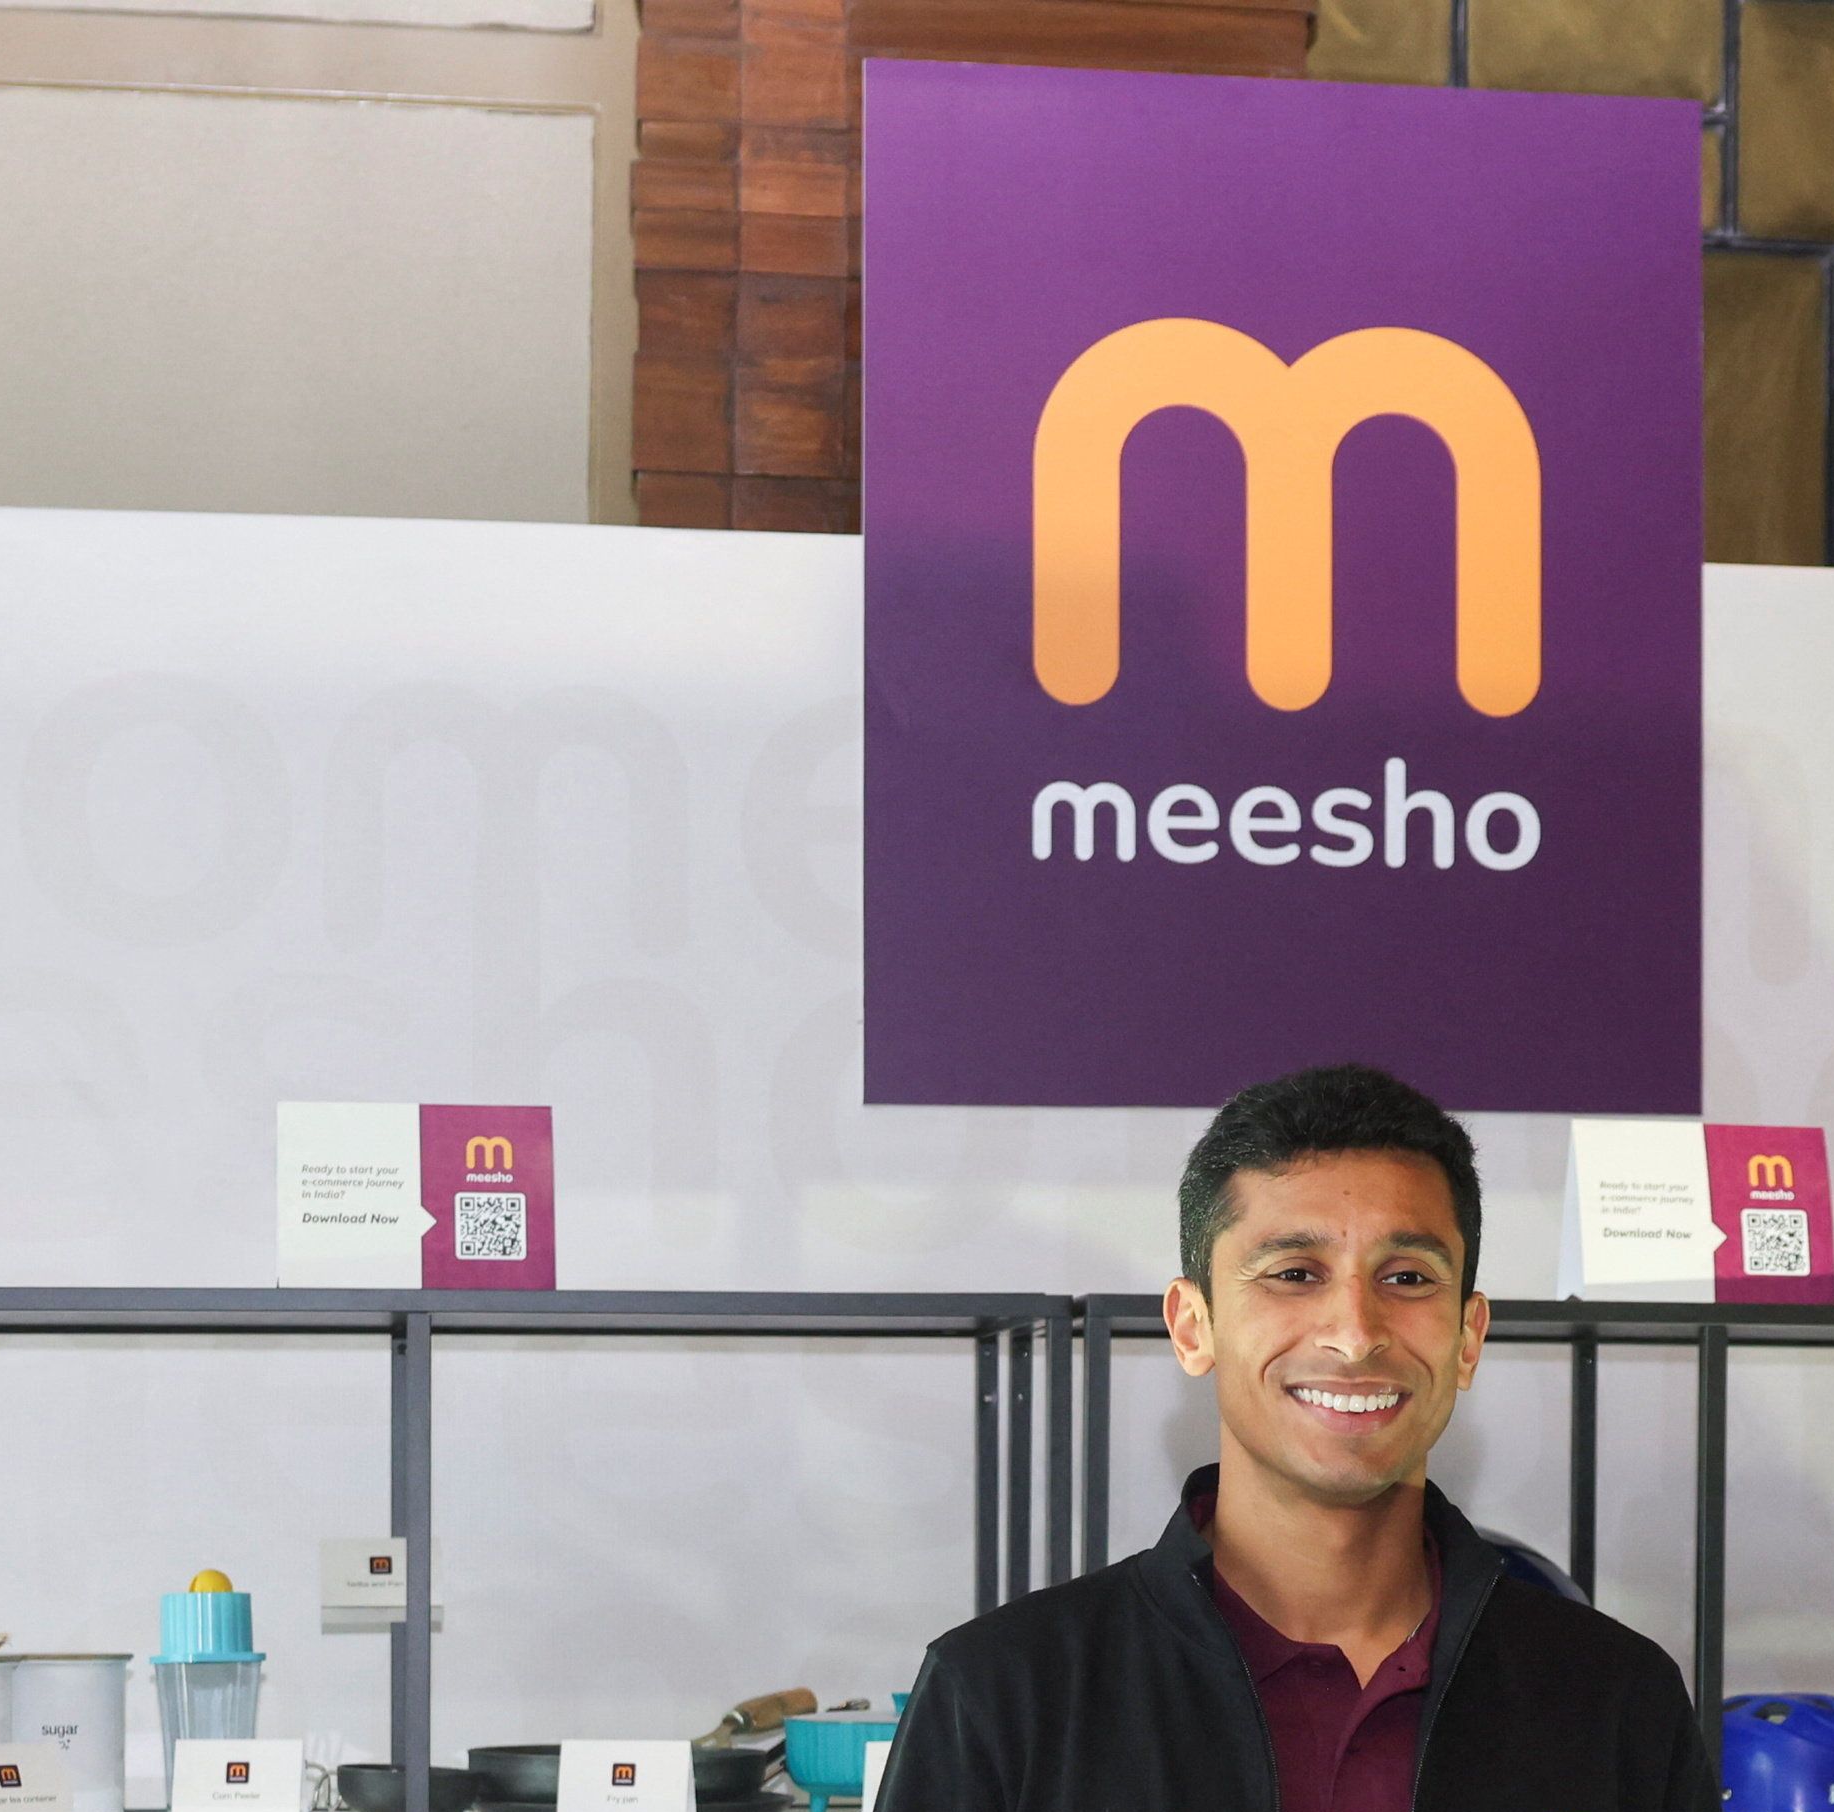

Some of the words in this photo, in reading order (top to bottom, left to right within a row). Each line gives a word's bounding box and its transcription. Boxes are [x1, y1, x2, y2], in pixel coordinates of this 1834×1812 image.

[1031, 757, 1540, 870] meesho
[301, 1164, 334, 1176] Ready
[336, 1165, 347, 1174] to
[349, 1165, 373, 1174] start
[376, 1167, 399, 1177] your
[466, 1171, 514, 1183] meesho
[301, 1178, 364, 1187] e-commerce
[365, 1178, 405, 1189] journey
[301, 1190, 312, 1199] in
[314, 1190, 346, 1199] India?
[302, 1212, 367, 1223] Download
[370, 1213, 399, 1224] Now
[1603, 1227, 1663, 1239] Download
[1666, 1229, 1693, 1239] Now
[41, 1723, 79, 1738] sugar
